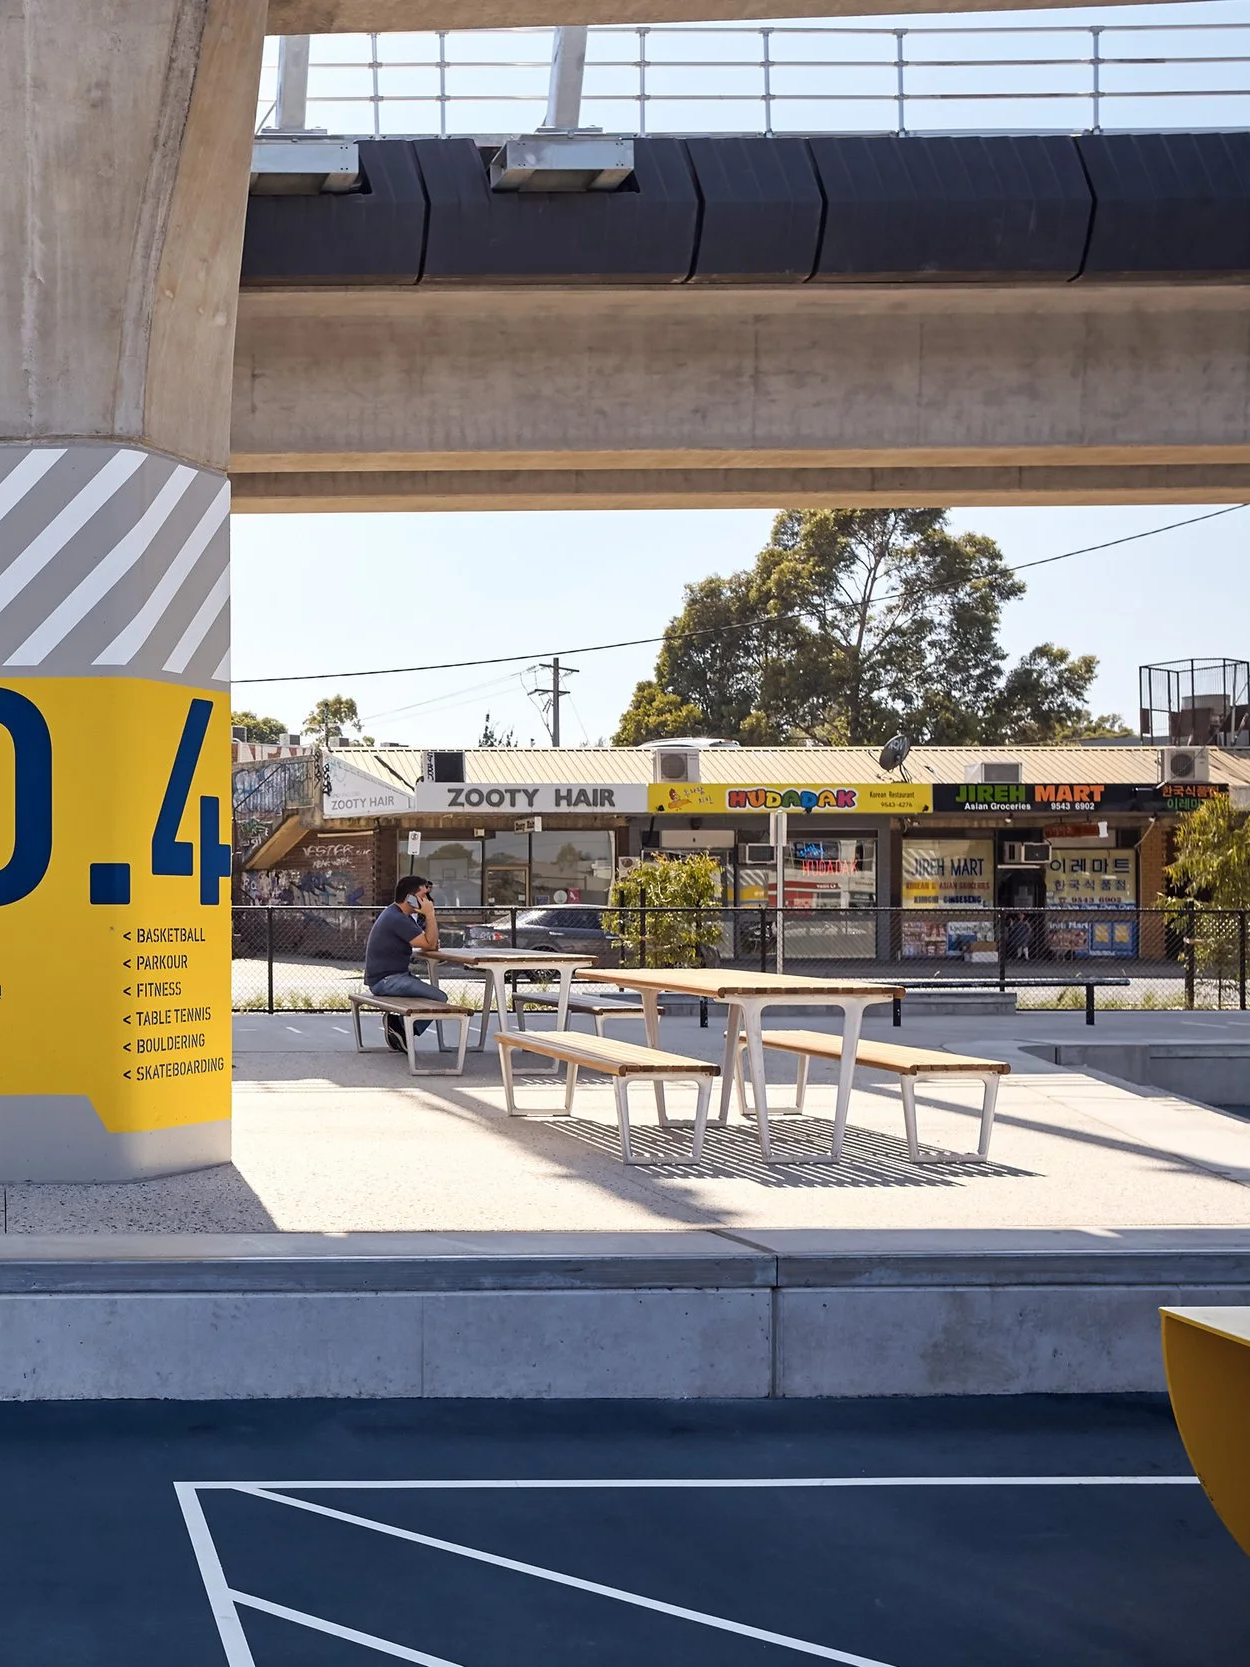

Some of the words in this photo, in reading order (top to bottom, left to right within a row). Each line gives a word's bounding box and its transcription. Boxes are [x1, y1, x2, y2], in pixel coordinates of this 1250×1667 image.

[447, 788, 540, 807] ZOOTY
[554, 788, 616, 807] HAIR
[727, 788, 857, 809] HUDADAK
[956, 785, 1026, 802] JIREH
[1034, 785, 1105, 802] MART
[331, 797, 367, 811] ZOOTY
[369, 796, 395, 808] HAIR
[964, 803, 989, 811] Asian
[990, 803, 1032, 811] Groceries
[1050, 802, 1071, 811] 9543
[1074, 802, 1095, 811] 6902
[913, 858, 945, 876] JIREH
[951, 858, 984, 876] MART
[1050, 858, 1130, 873] 이레마트
[137, 928, 206, 943] BASKETBALL
[137, 954, 188, 970] PARKOUR
[137, 981, 182, 998] FITNESS
[136, 1009, 171, 1026] TABLE
[174, 1007, 211, 1023] TENNIS
[137, 1033, 205, 1053] BOULDERING
[136, 1057, 224, 1081] SKATEBOARDING
